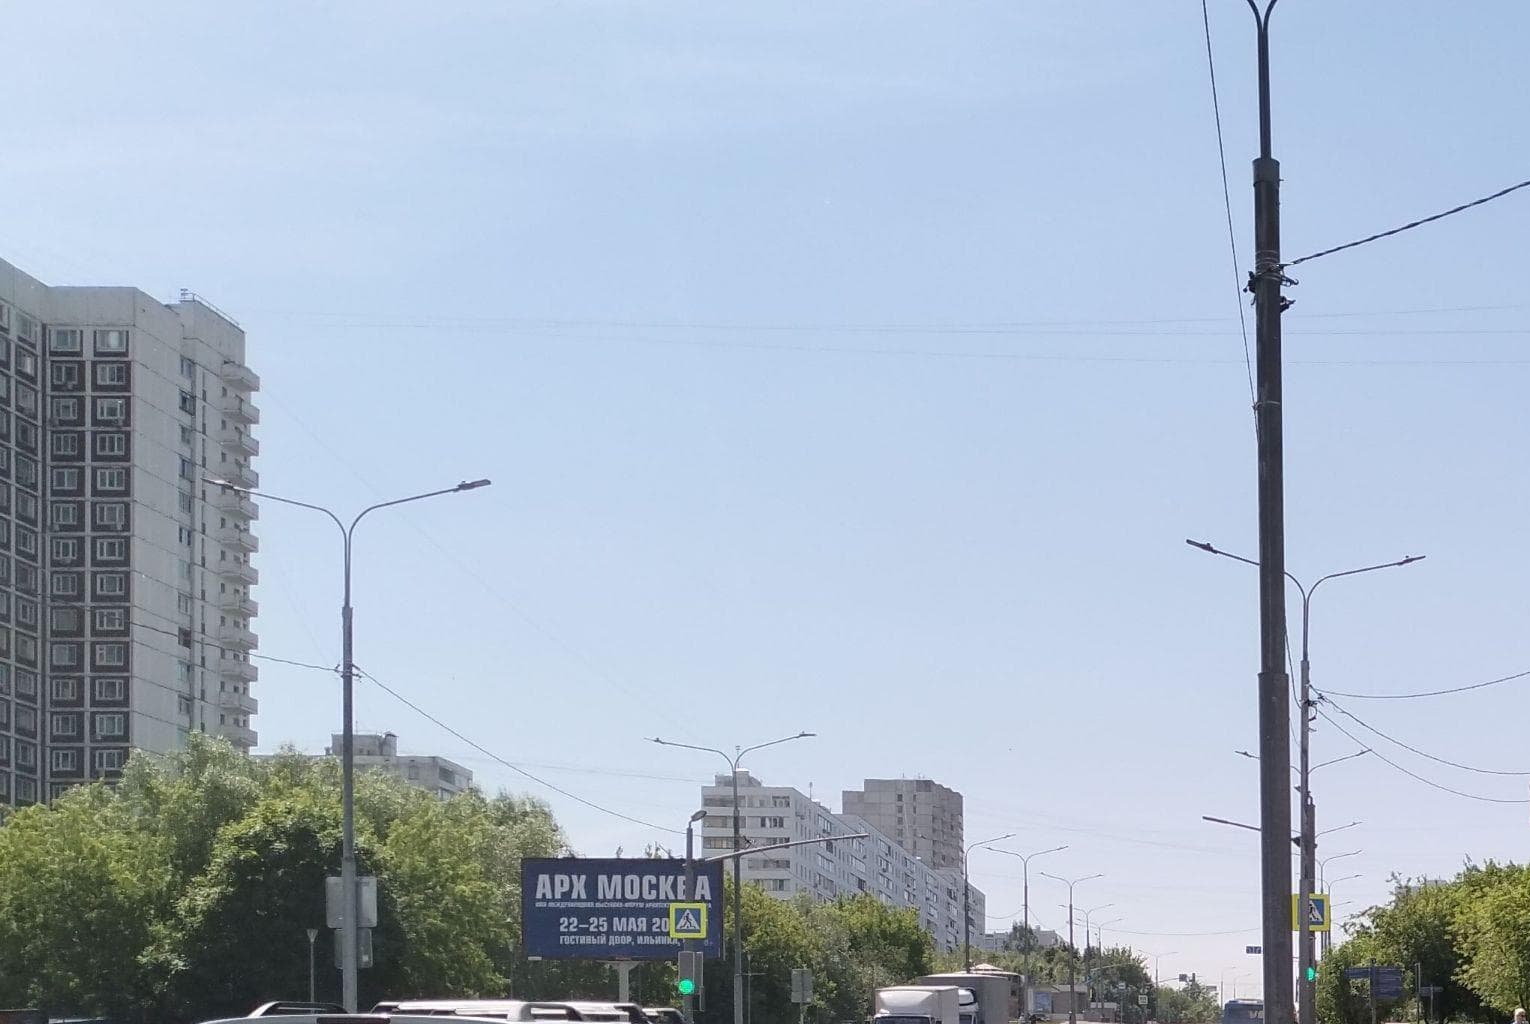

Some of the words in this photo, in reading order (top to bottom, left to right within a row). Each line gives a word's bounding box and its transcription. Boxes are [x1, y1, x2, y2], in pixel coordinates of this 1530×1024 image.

[536, 874, 587, 900] АРХ
[613, 918, 647, 932] МАЯ
[559, 934, 606, 945] ГОСТИНЫЙ
[608, 936, 635, 946] ДВОР,
